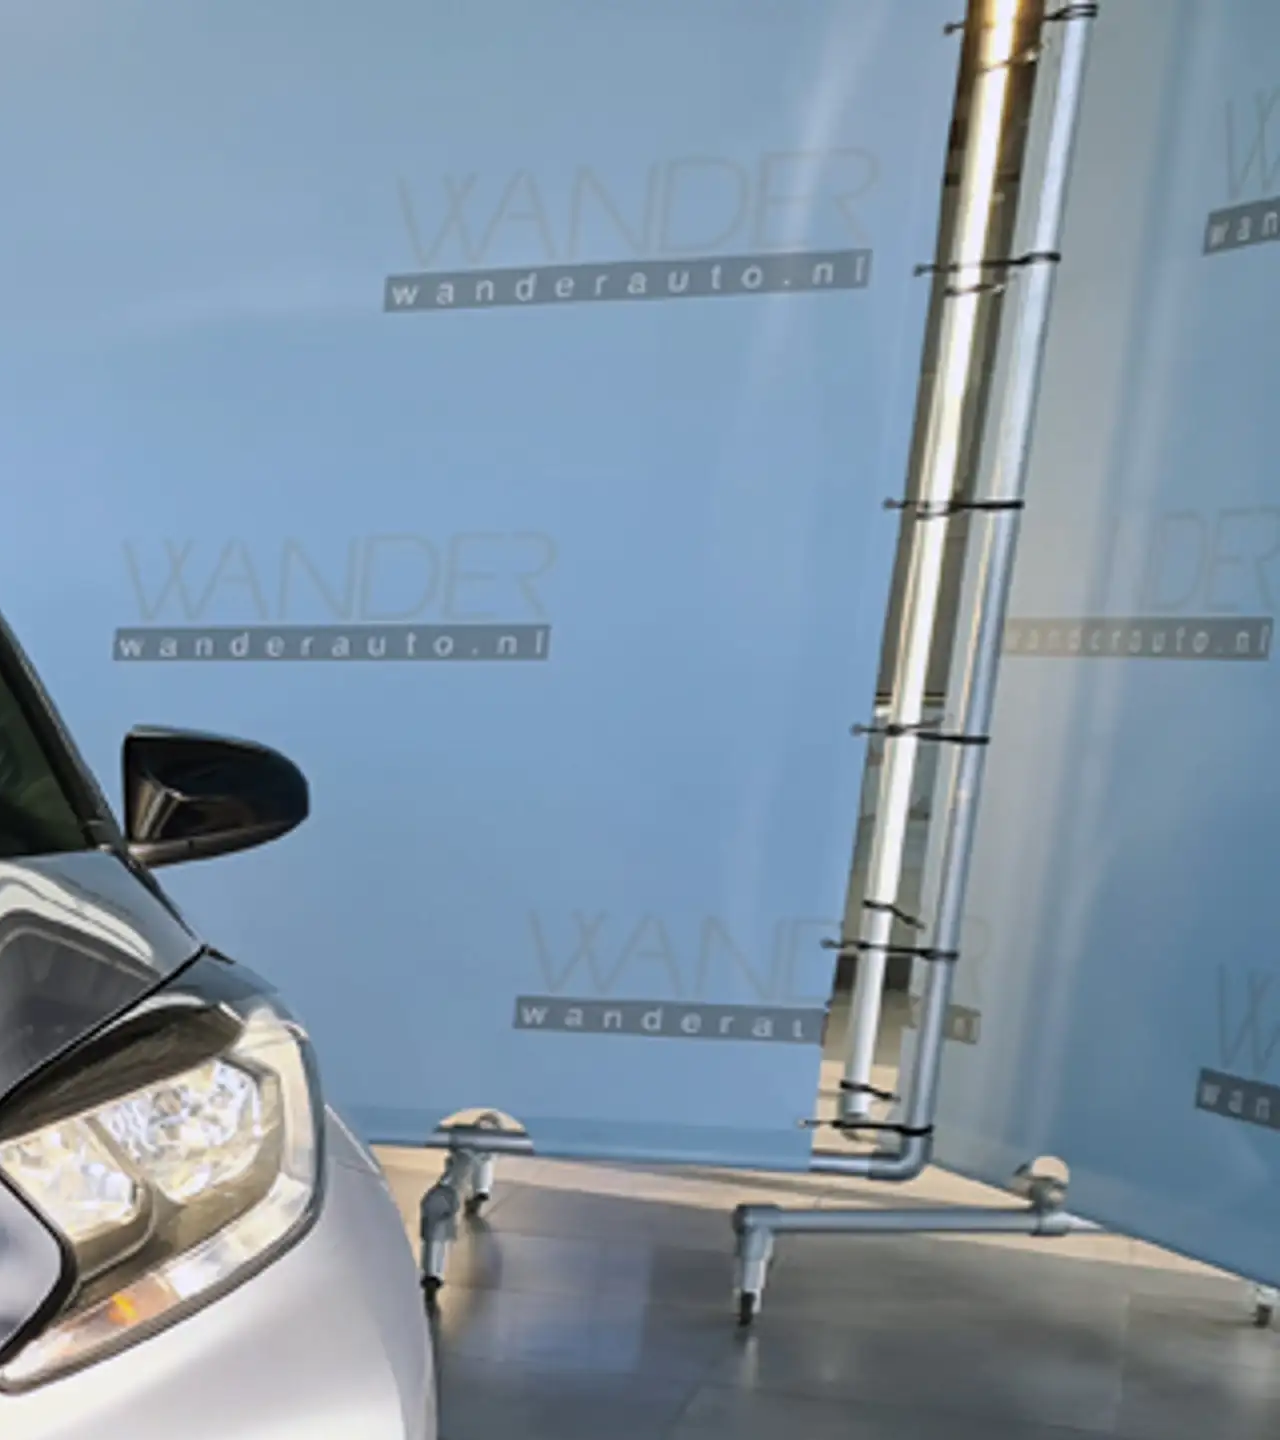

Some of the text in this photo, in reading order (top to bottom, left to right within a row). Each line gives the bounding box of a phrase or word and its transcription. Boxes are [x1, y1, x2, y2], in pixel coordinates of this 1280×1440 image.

[394, 146, 879, 267] WANDER
[392, 255, 867, 307] wanderauto.nl
[121, 530, 558, 622] WANDER
[119, 629, 546, 660] wanderauto.nl
